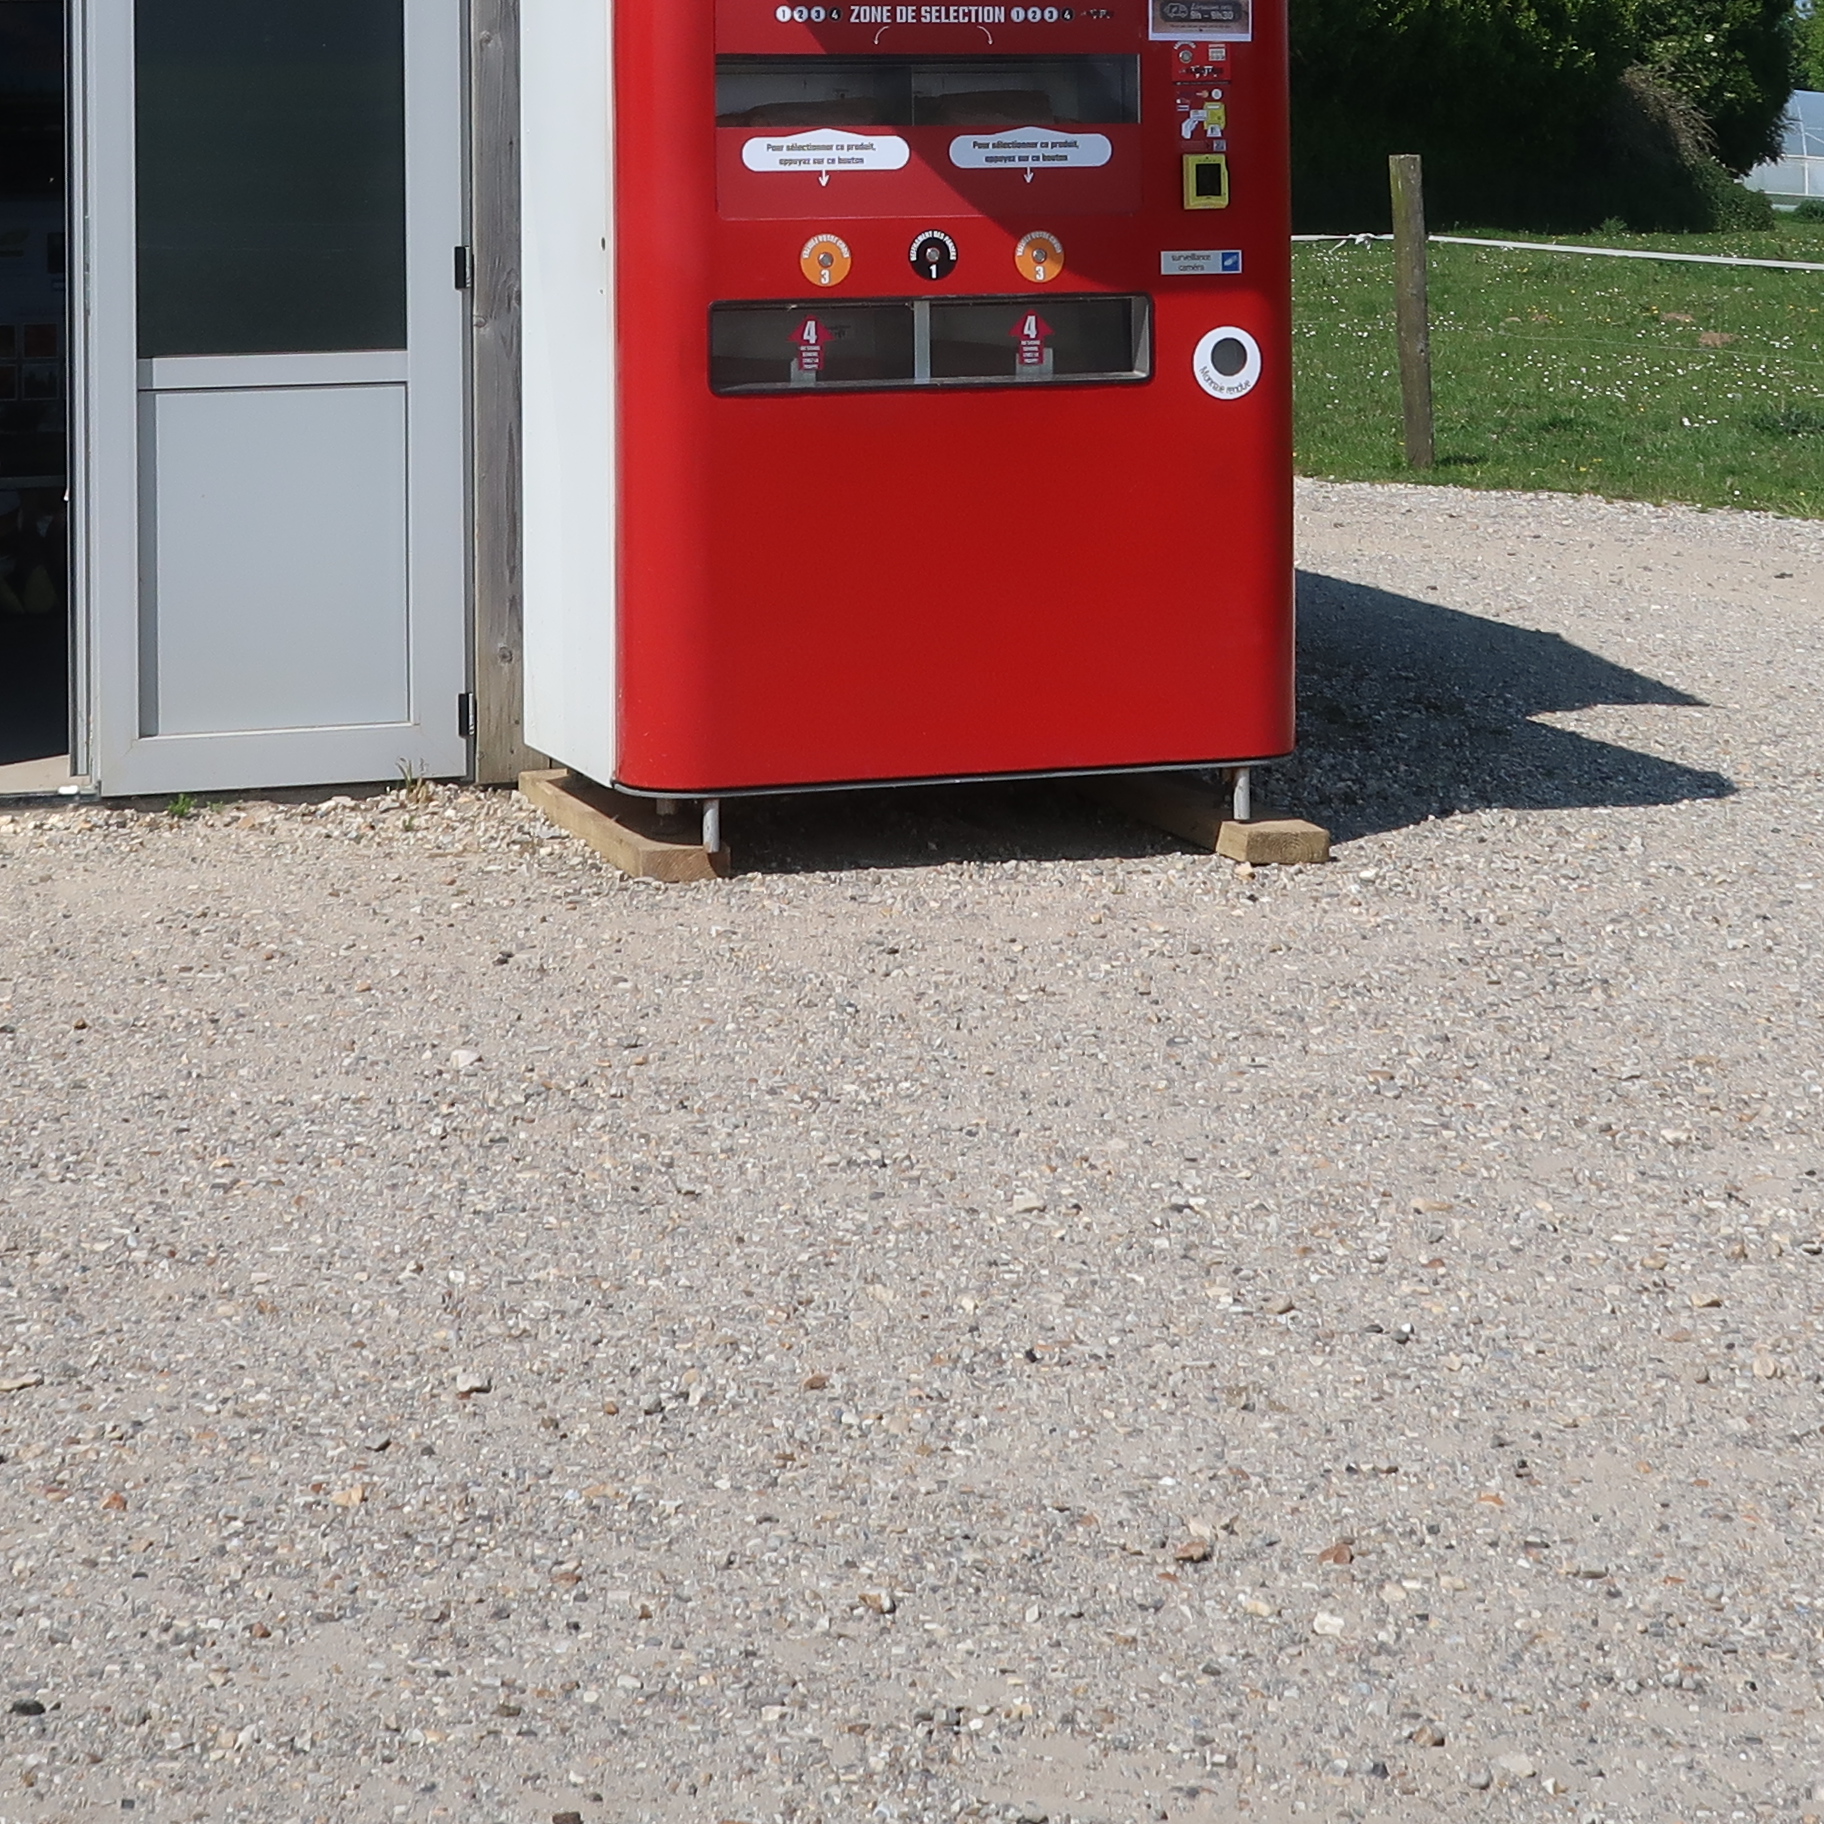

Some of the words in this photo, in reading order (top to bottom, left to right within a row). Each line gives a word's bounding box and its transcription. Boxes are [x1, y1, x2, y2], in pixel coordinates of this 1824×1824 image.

[849, 5, 892, 23] ZONE
[896, 5, 917, 23] DE
[920, 6, 1005, 23] SELECTION
[766, 143, 784, 152] Pour
[838, 156, 864, 165] bouton
[820, 268, 831, 285] 3
[929, 264, 938, 279] 1
[1035, 265, 1045, 280] 3
[803, 320, 817, 344] 4
[1023, 315, 1037, 339] 4
